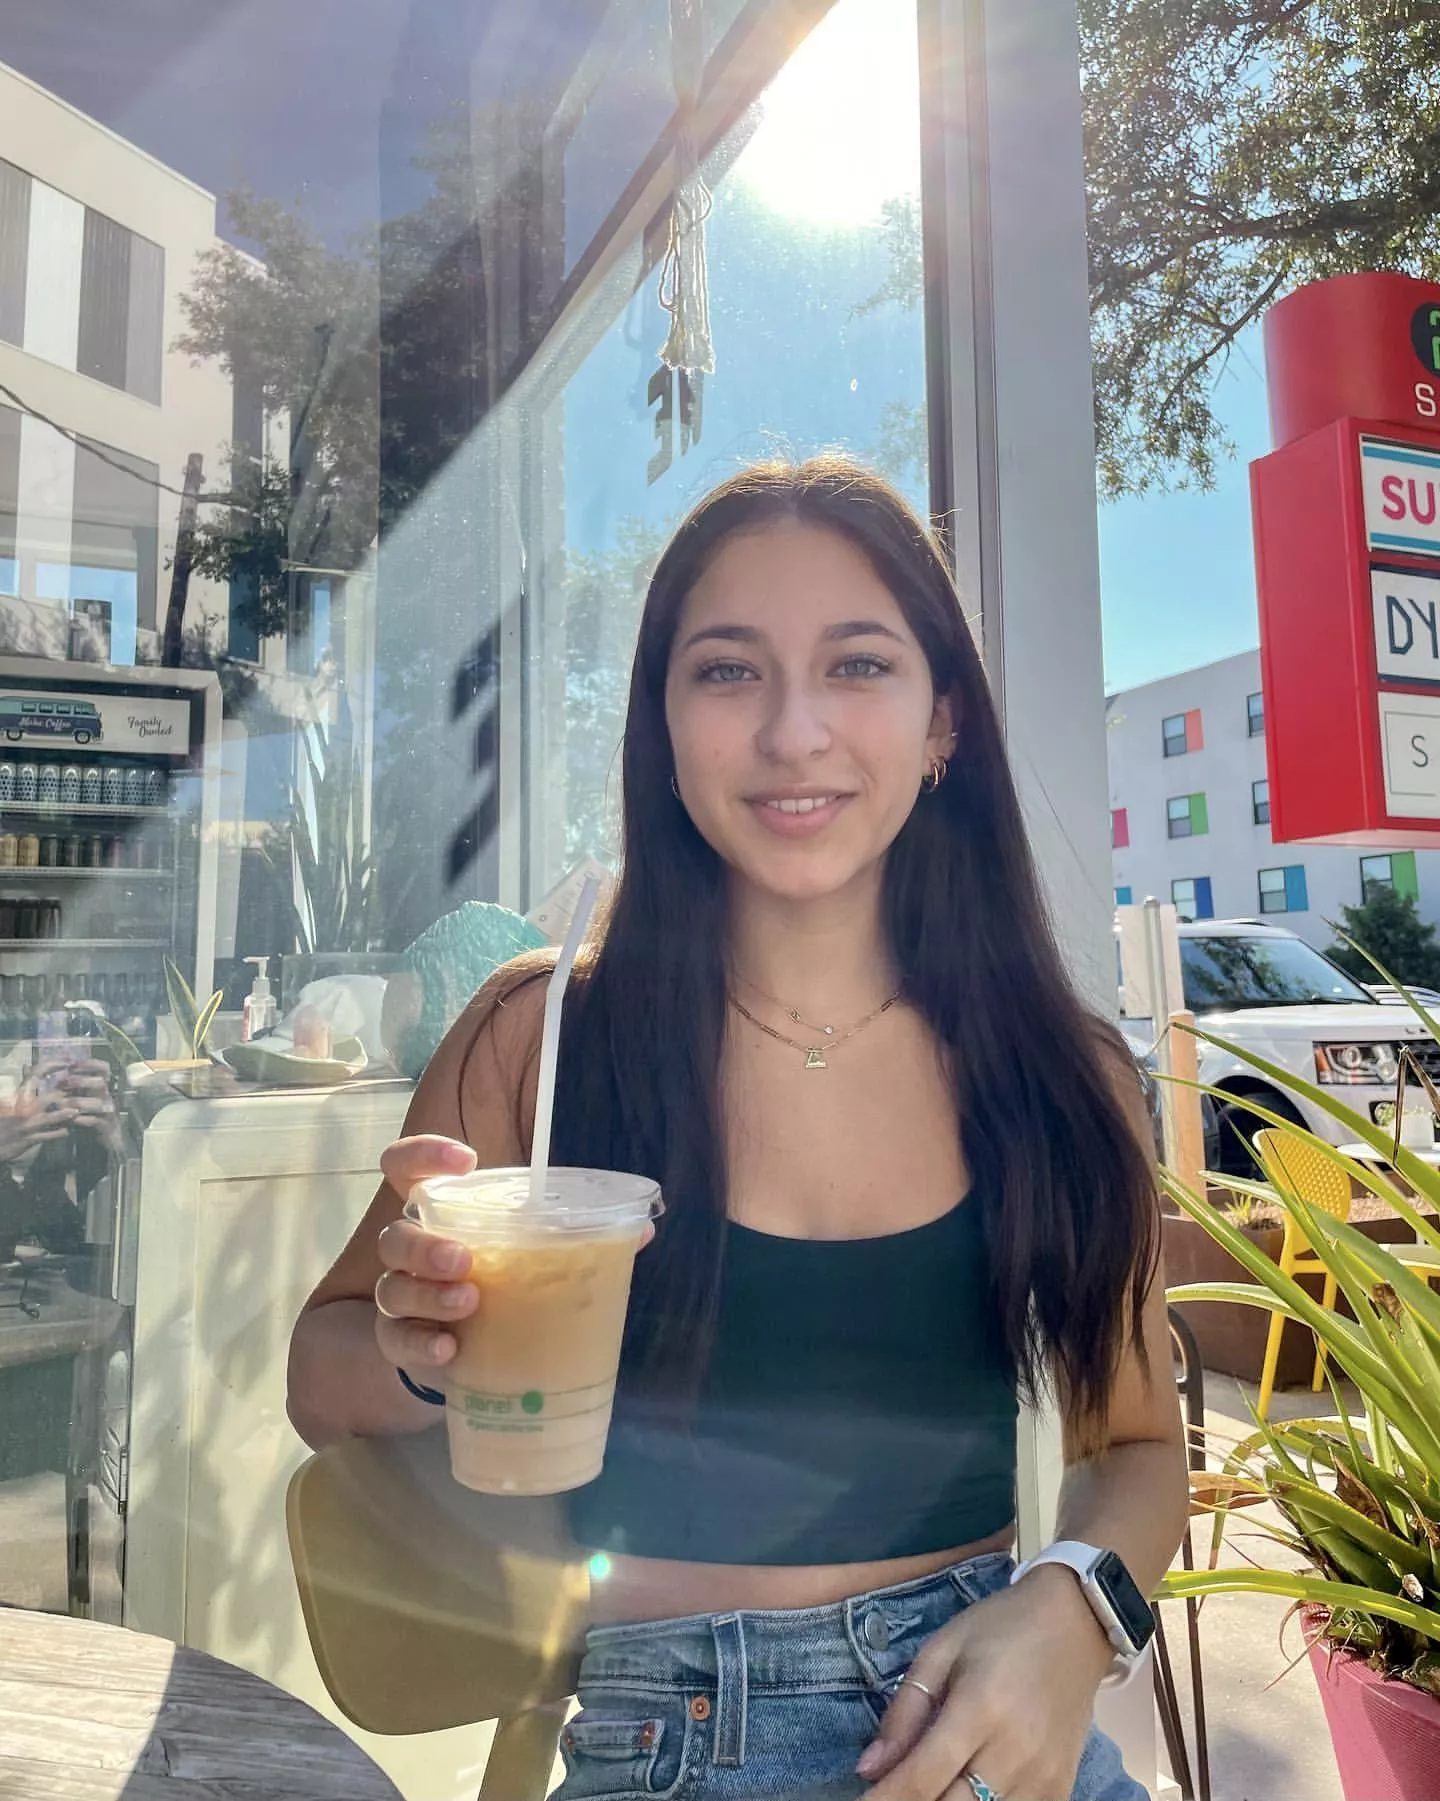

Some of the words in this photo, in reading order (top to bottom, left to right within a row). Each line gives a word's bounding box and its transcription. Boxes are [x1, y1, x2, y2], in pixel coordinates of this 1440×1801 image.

[1414, 382, 1437, 417] S
[1381, 474, 1437, 526] SU
[1385, 594, 1440, 660] DY
[1410, 734, 1429, 769] S
